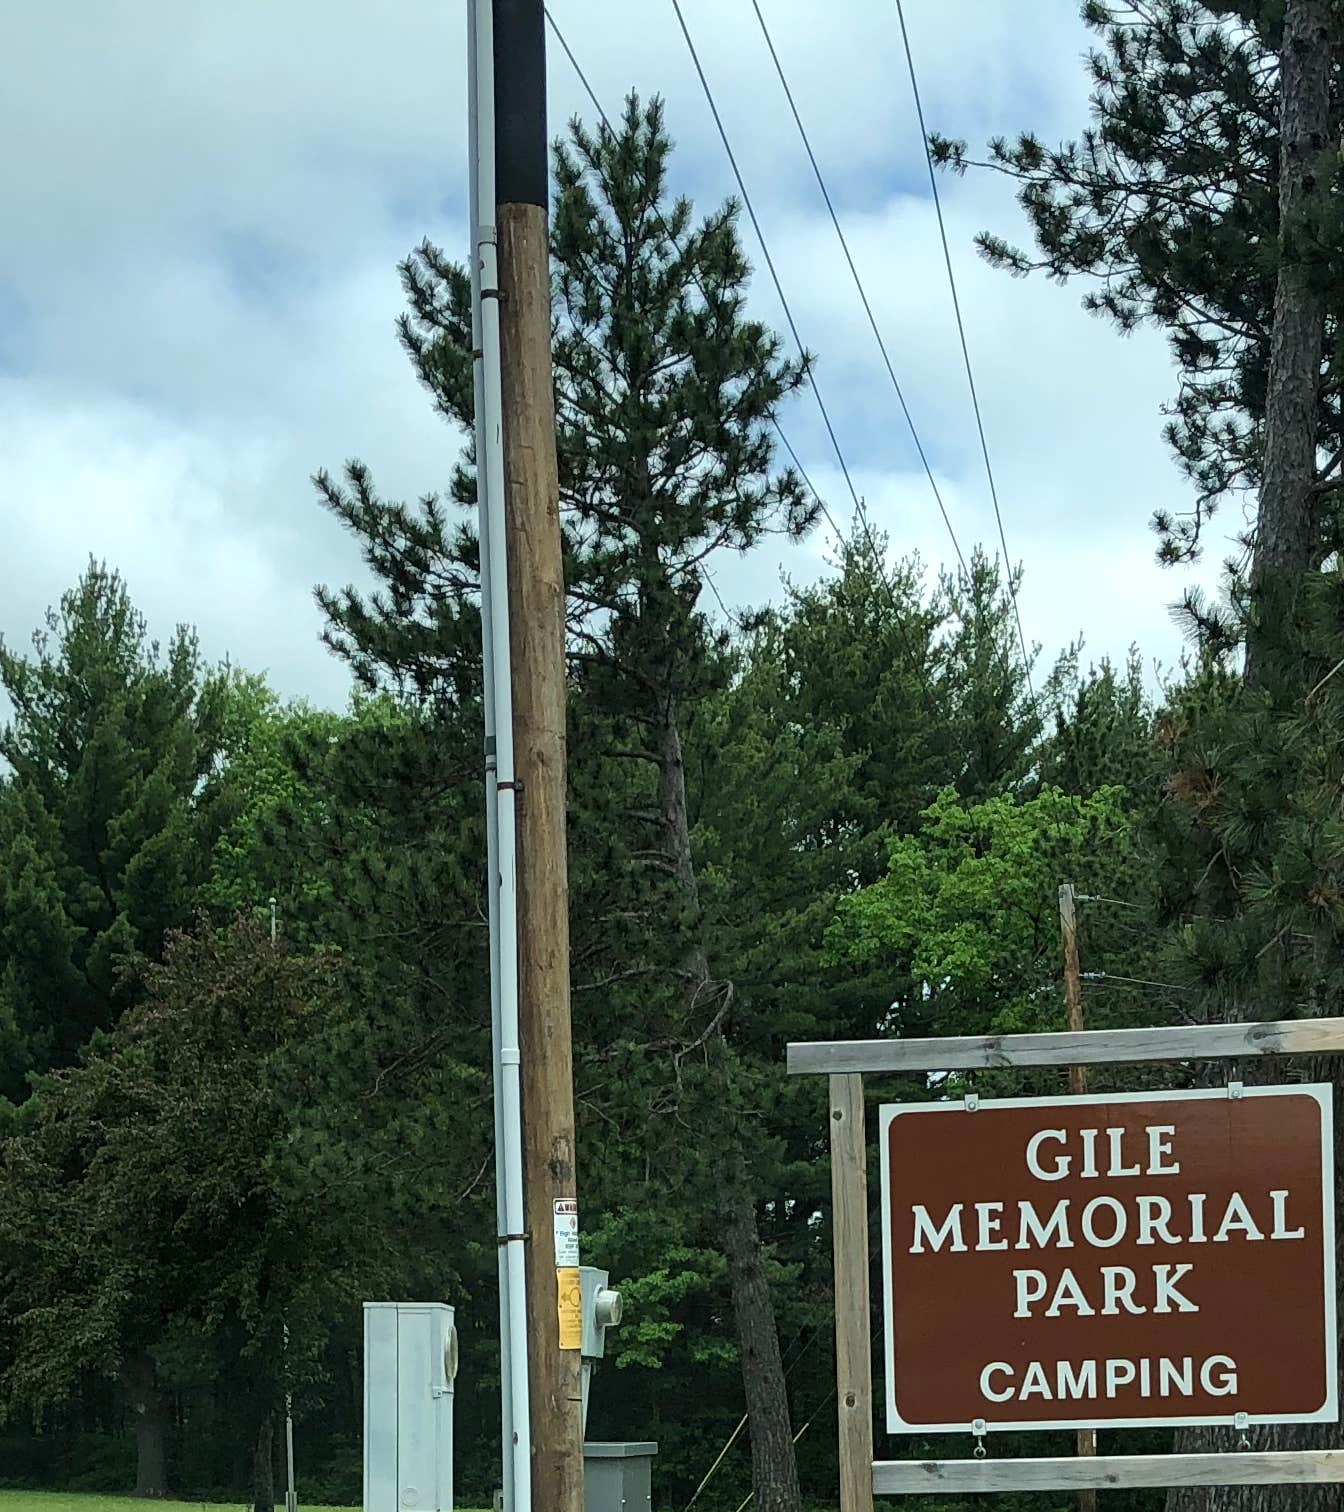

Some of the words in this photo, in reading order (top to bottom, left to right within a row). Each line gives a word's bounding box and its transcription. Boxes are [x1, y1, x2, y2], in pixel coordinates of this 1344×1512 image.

[1027, 1126, 1180, 1180] GILE
[909, 1191, 1305, 1253] MEMORIAL
[1013, 1264, 1199, 1317] PARK
[980, 1356, 1238, 1402] CAMPING
